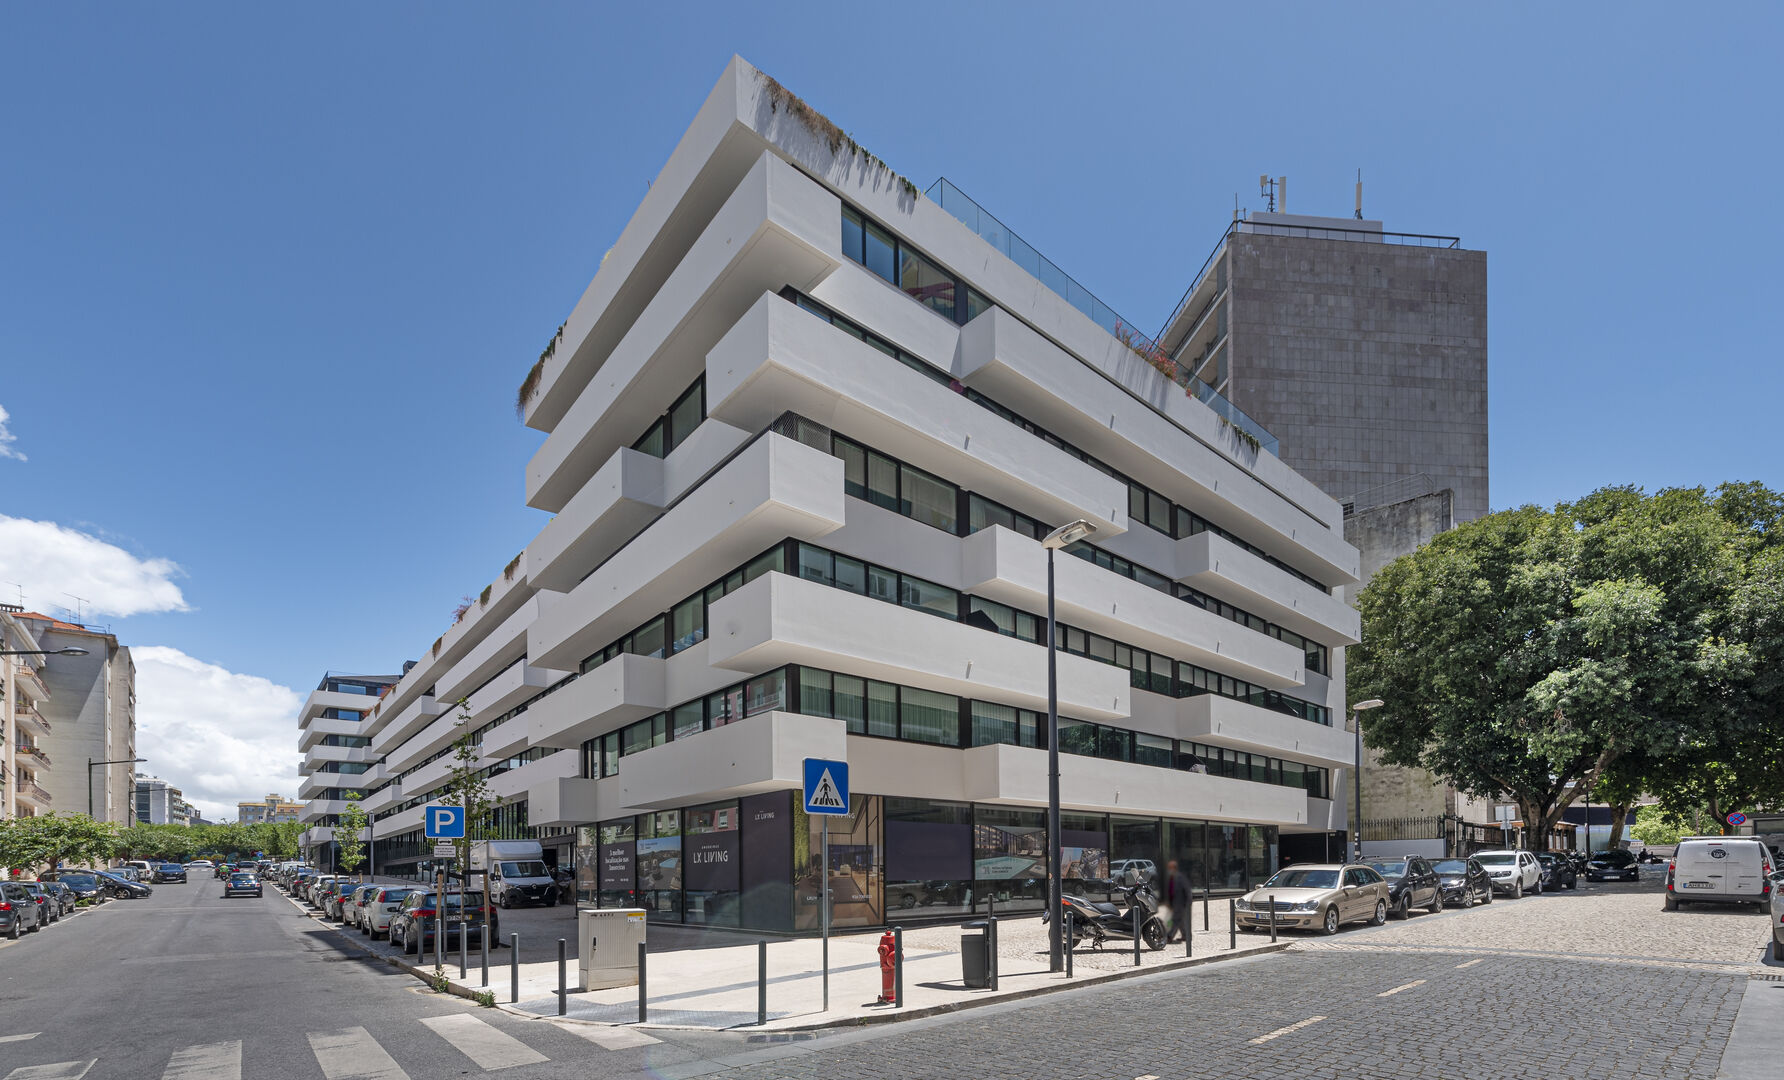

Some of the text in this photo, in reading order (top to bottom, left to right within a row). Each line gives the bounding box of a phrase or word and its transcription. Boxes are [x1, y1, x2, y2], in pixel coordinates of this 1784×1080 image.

[435, 809, 455, 834] P
[693, 850, 729, 864] LX LIVING
